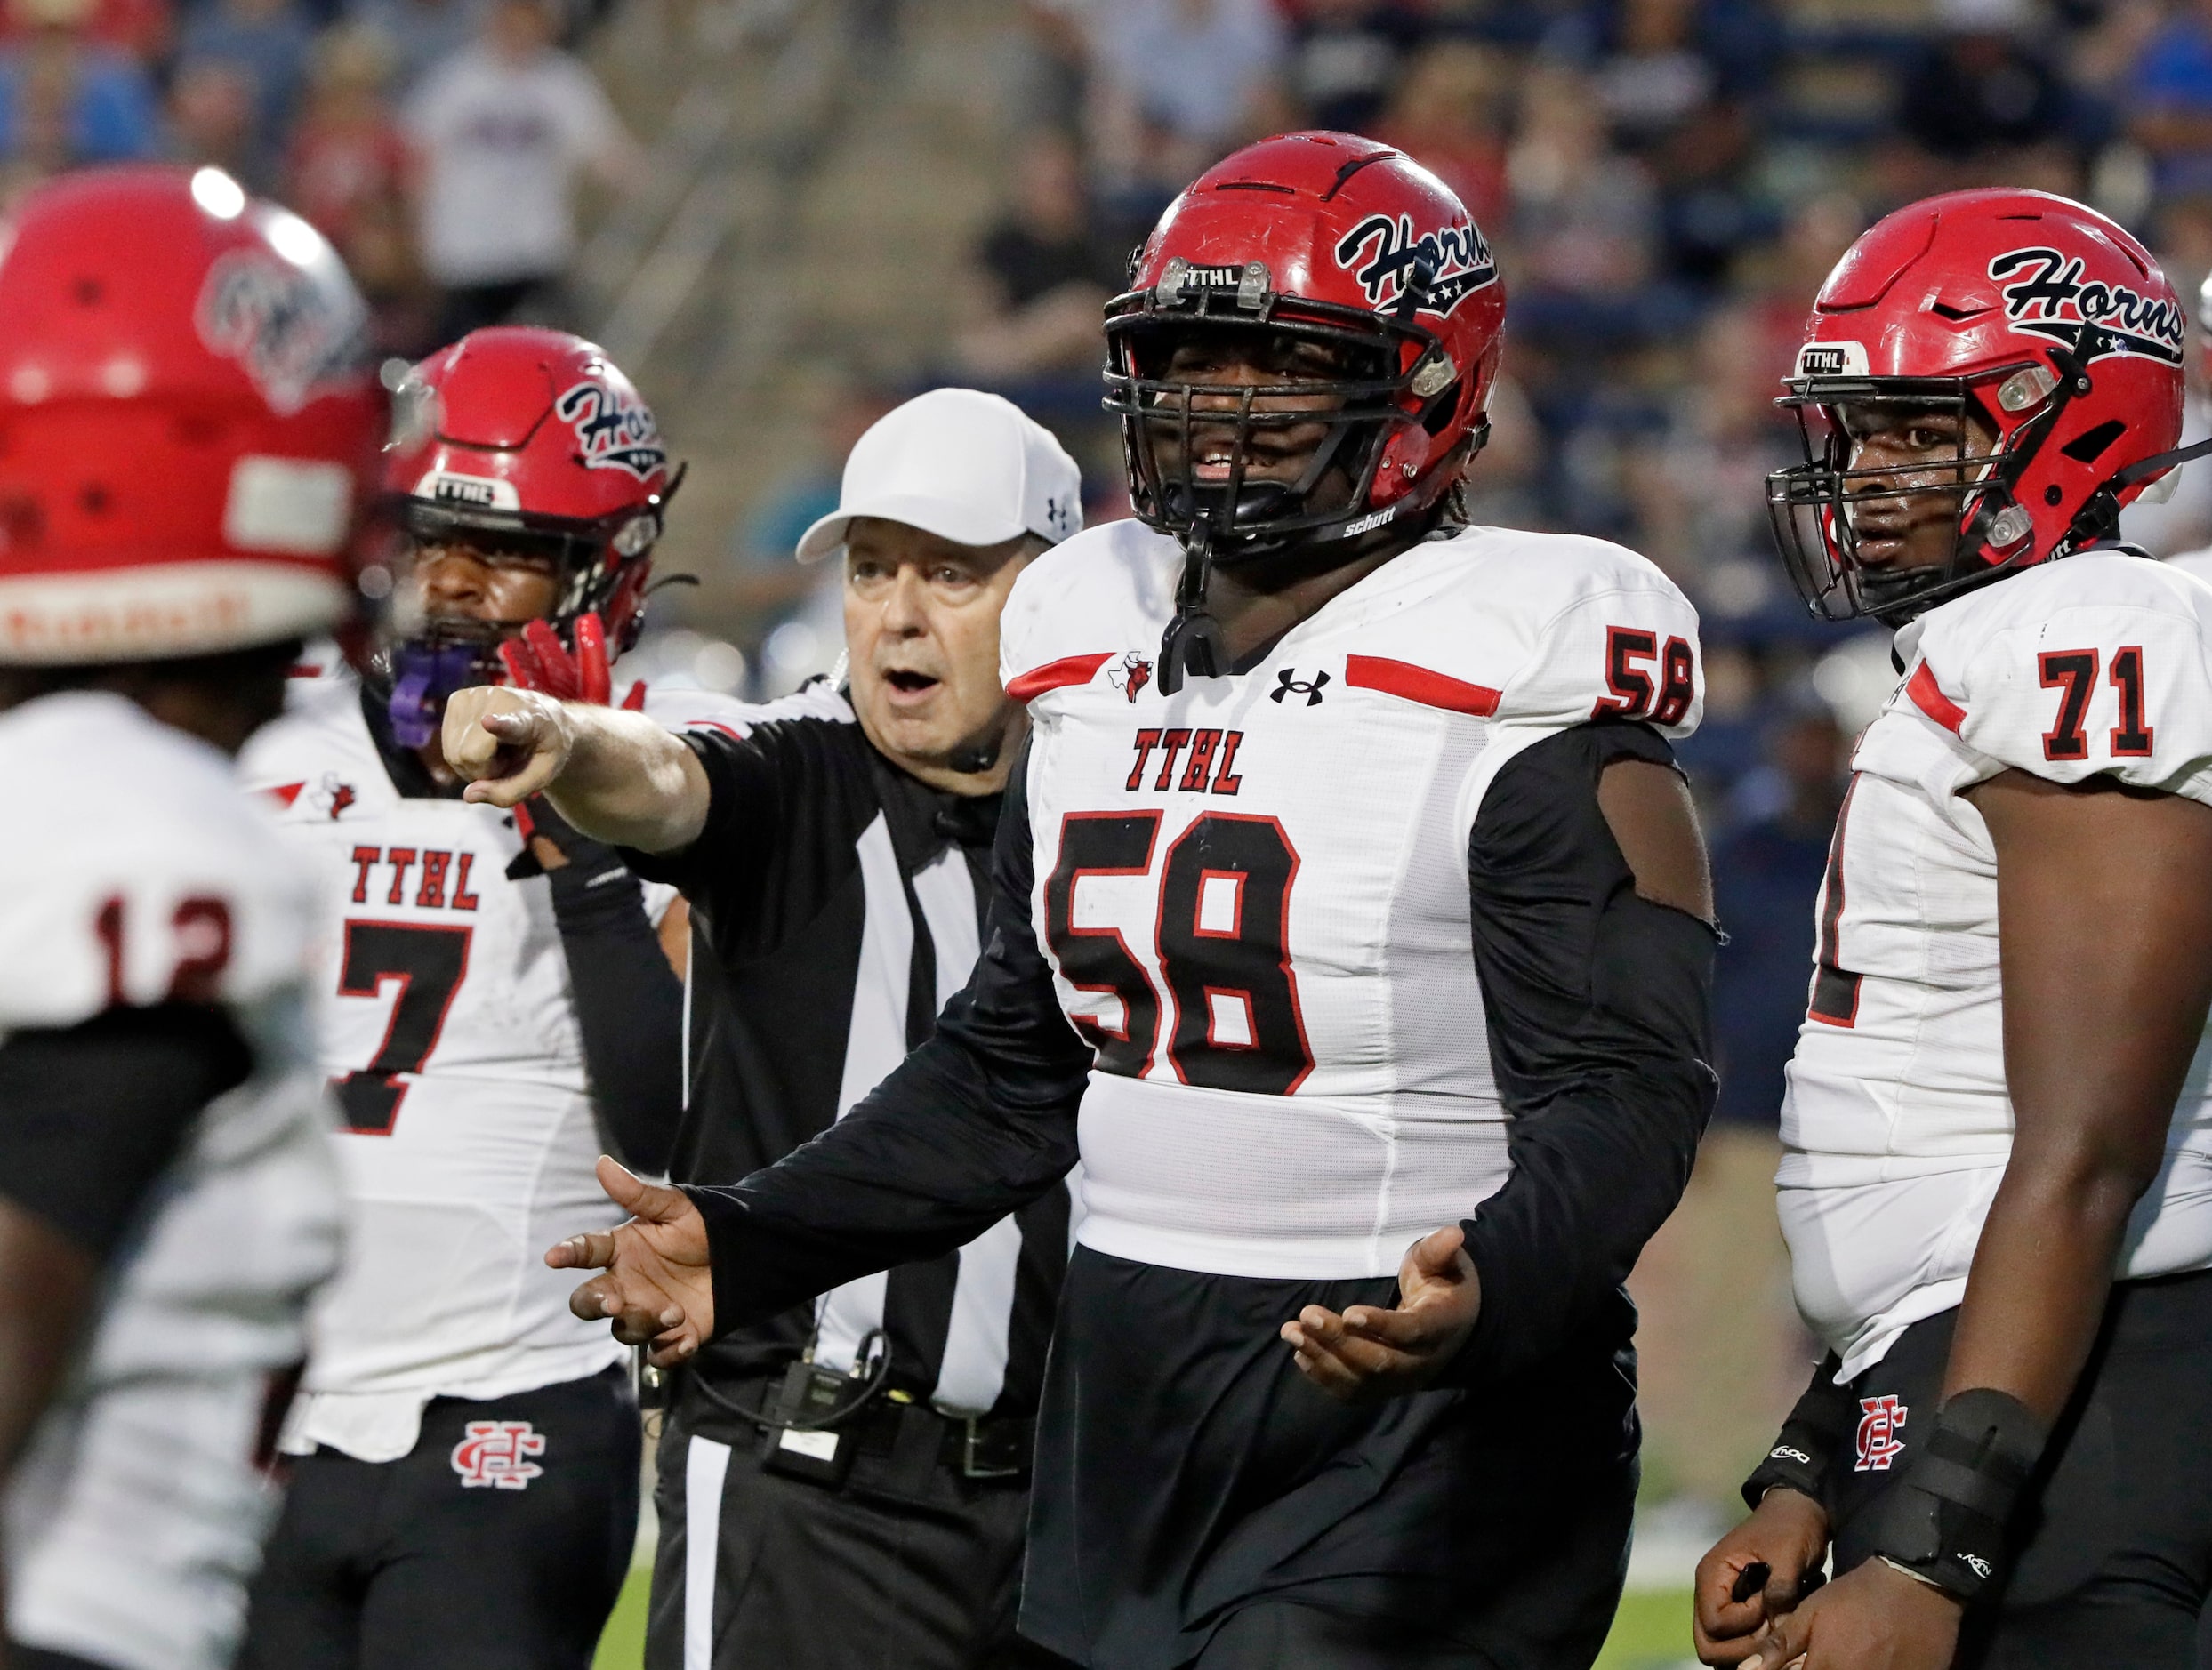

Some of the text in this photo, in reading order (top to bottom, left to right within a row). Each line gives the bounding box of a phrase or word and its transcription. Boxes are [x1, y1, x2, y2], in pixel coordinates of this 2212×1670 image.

[1186, 269, 1239, 286] TTHL
[1988, 245, 2185, 347] Horns
[1806, 351, 1841, 369] TTHL
[1343, 505, 1396, 538] schutt
[1589, 624, 1694, 727] 58
[2037, 645, 2154, 762] 71
[1126, 727, 1243, 796] TTHL
[351, 846, 479, 911] TTHL
[1044, 808, 1316, 1096] 58
[323, 917, 474, 1136] 7
